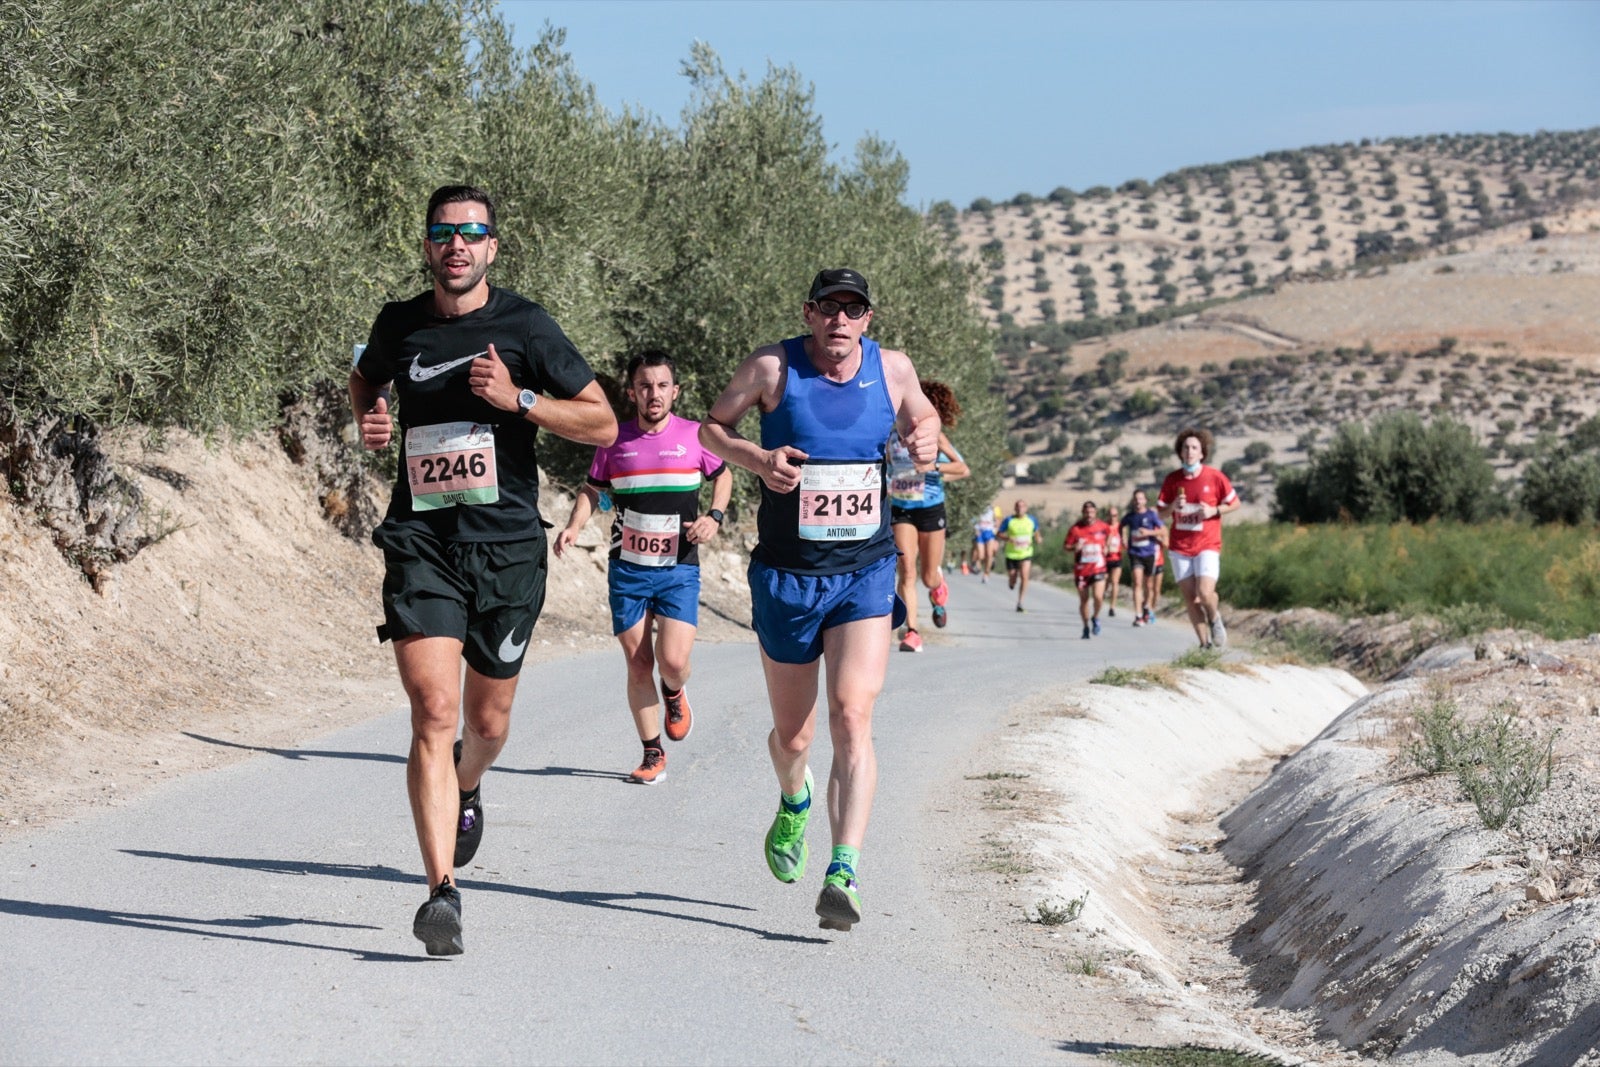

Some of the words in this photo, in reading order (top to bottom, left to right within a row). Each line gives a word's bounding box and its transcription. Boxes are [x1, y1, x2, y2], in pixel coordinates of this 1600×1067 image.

[420, 453, 486, 483] 2246
[442, 493, 467, 504] DANIEL
[813, 493, 873, 516] 2134
[826, 527, 857, 537] ANTONIO
[629, 534, 671, 553] 1063
